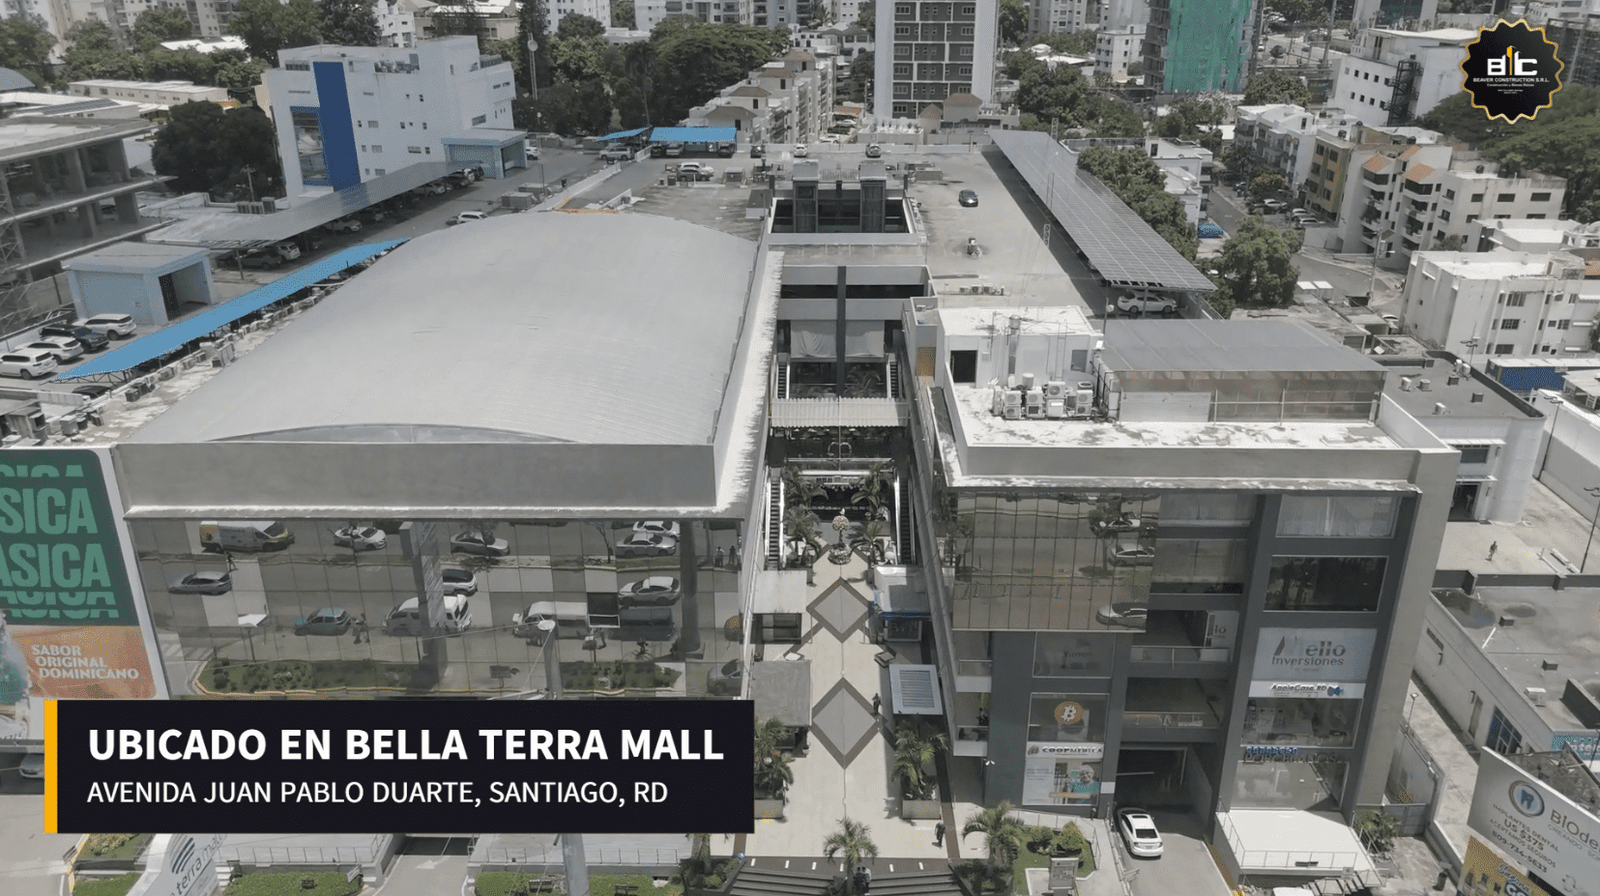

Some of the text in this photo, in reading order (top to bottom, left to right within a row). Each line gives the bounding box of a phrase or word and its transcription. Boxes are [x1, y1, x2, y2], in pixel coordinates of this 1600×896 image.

[32, 644, 83, 657] SABOR
[35, 655, 107, 669] ORIGINAL
[1271, 656, 1345, 667] Inversiones
[39, 667, 140, 680] DOMINICANO
[1493, 804, 1560, 853] IMPLANTES DENTAL
[1504, 819, 1545, 851] US $375
[1489, 818, 1557, 868] ACEPTAMOS SEGUROS
[176, 857, 202, 895] terra
